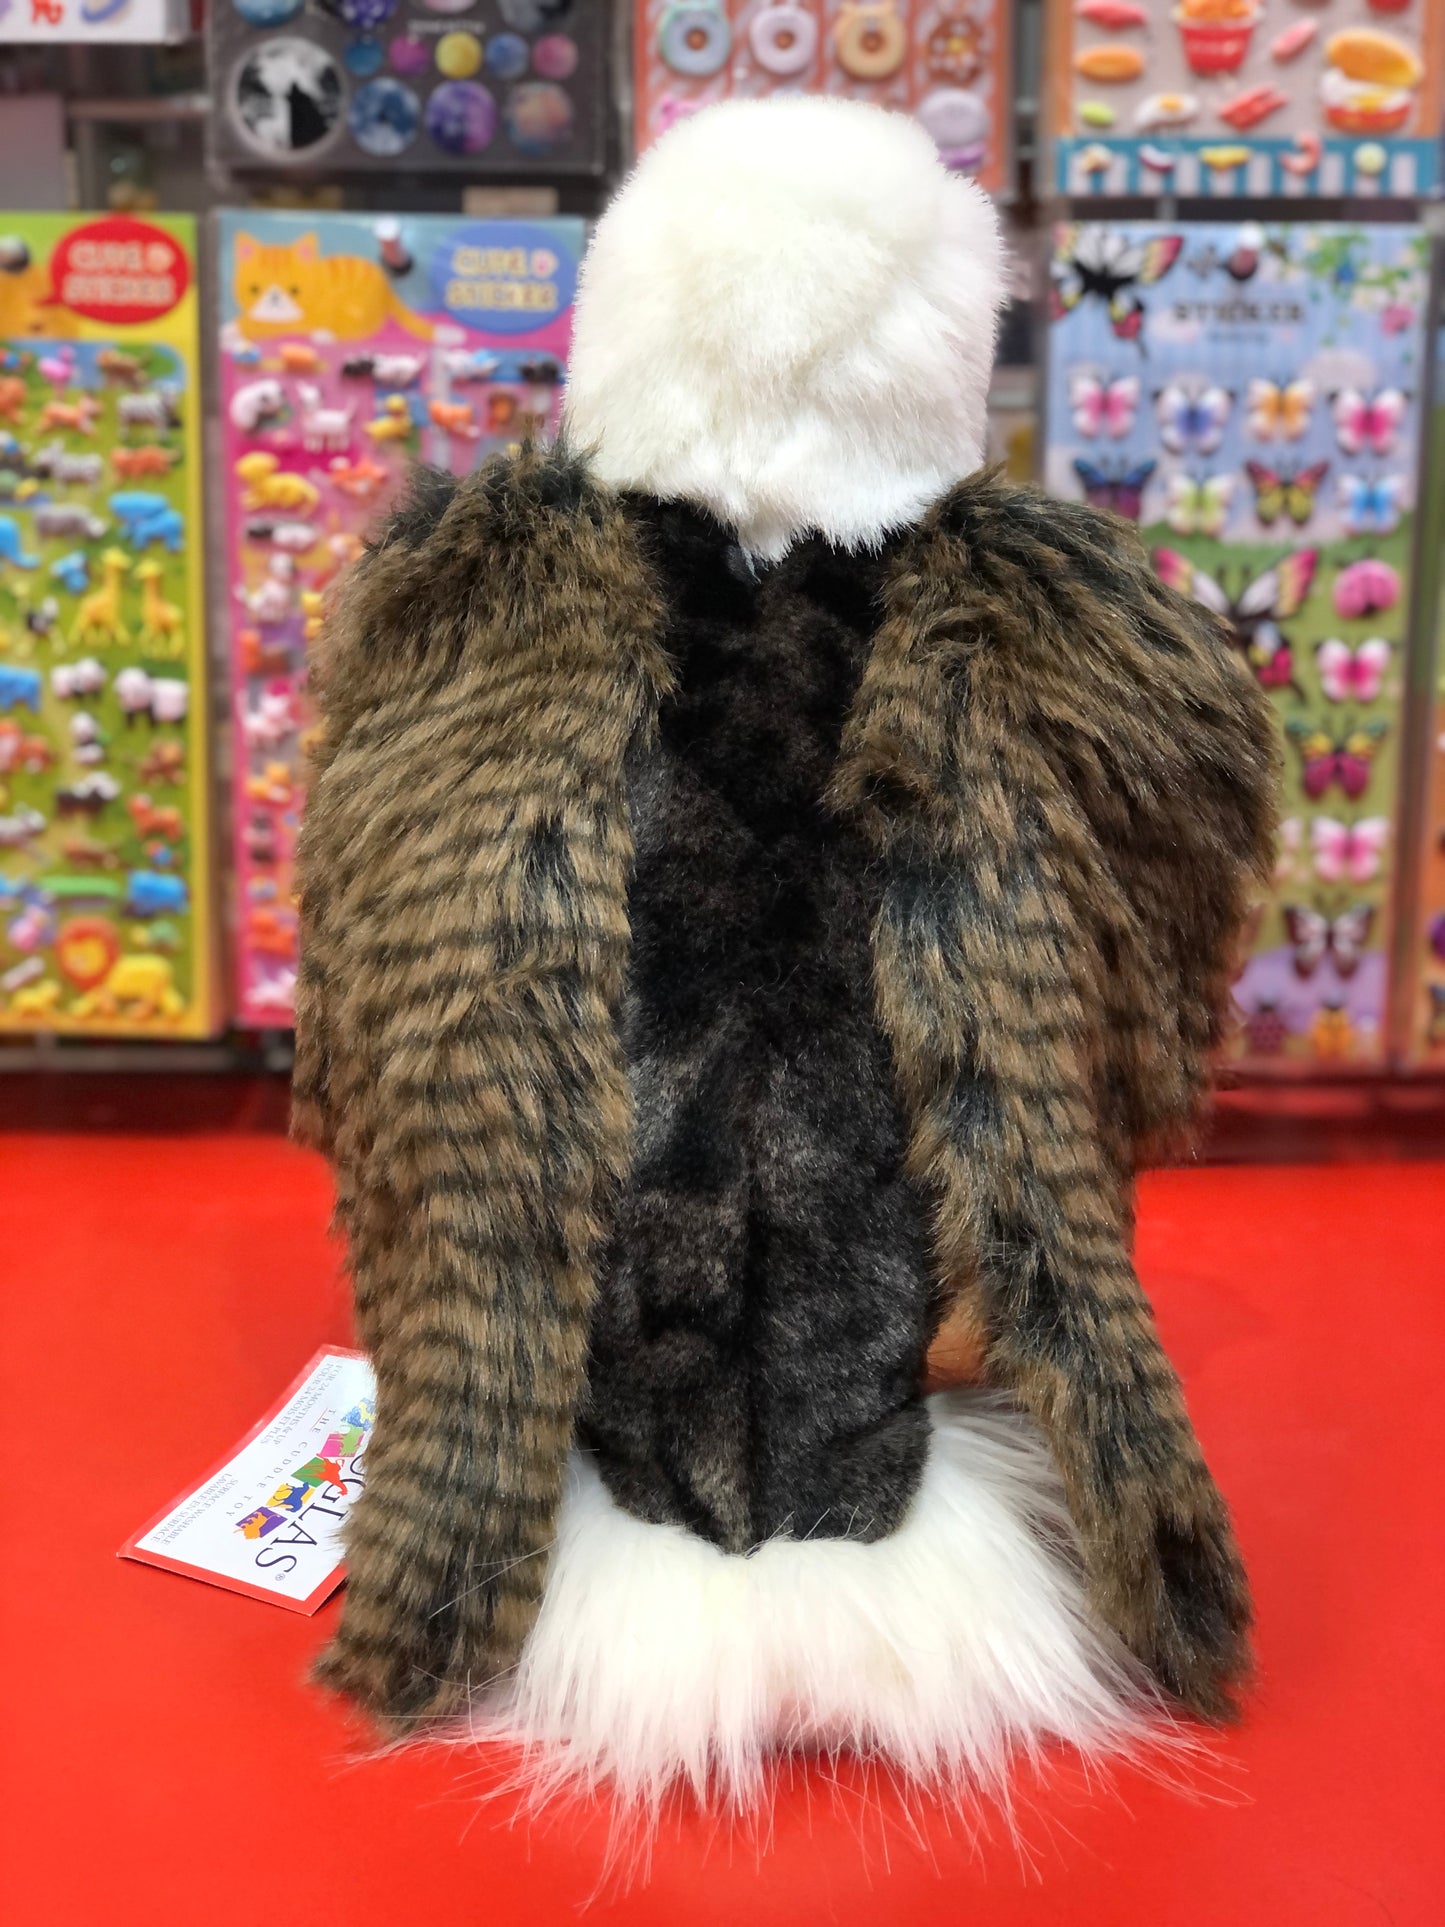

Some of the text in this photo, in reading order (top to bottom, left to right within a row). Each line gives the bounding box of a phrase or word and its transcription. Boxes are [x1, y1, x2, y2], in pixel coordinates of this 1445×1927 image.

[226, 1408, 336, 1516] THE CUDDLE TOY
[161, 1479, 239, 1546] SURFACE WASHABLE
